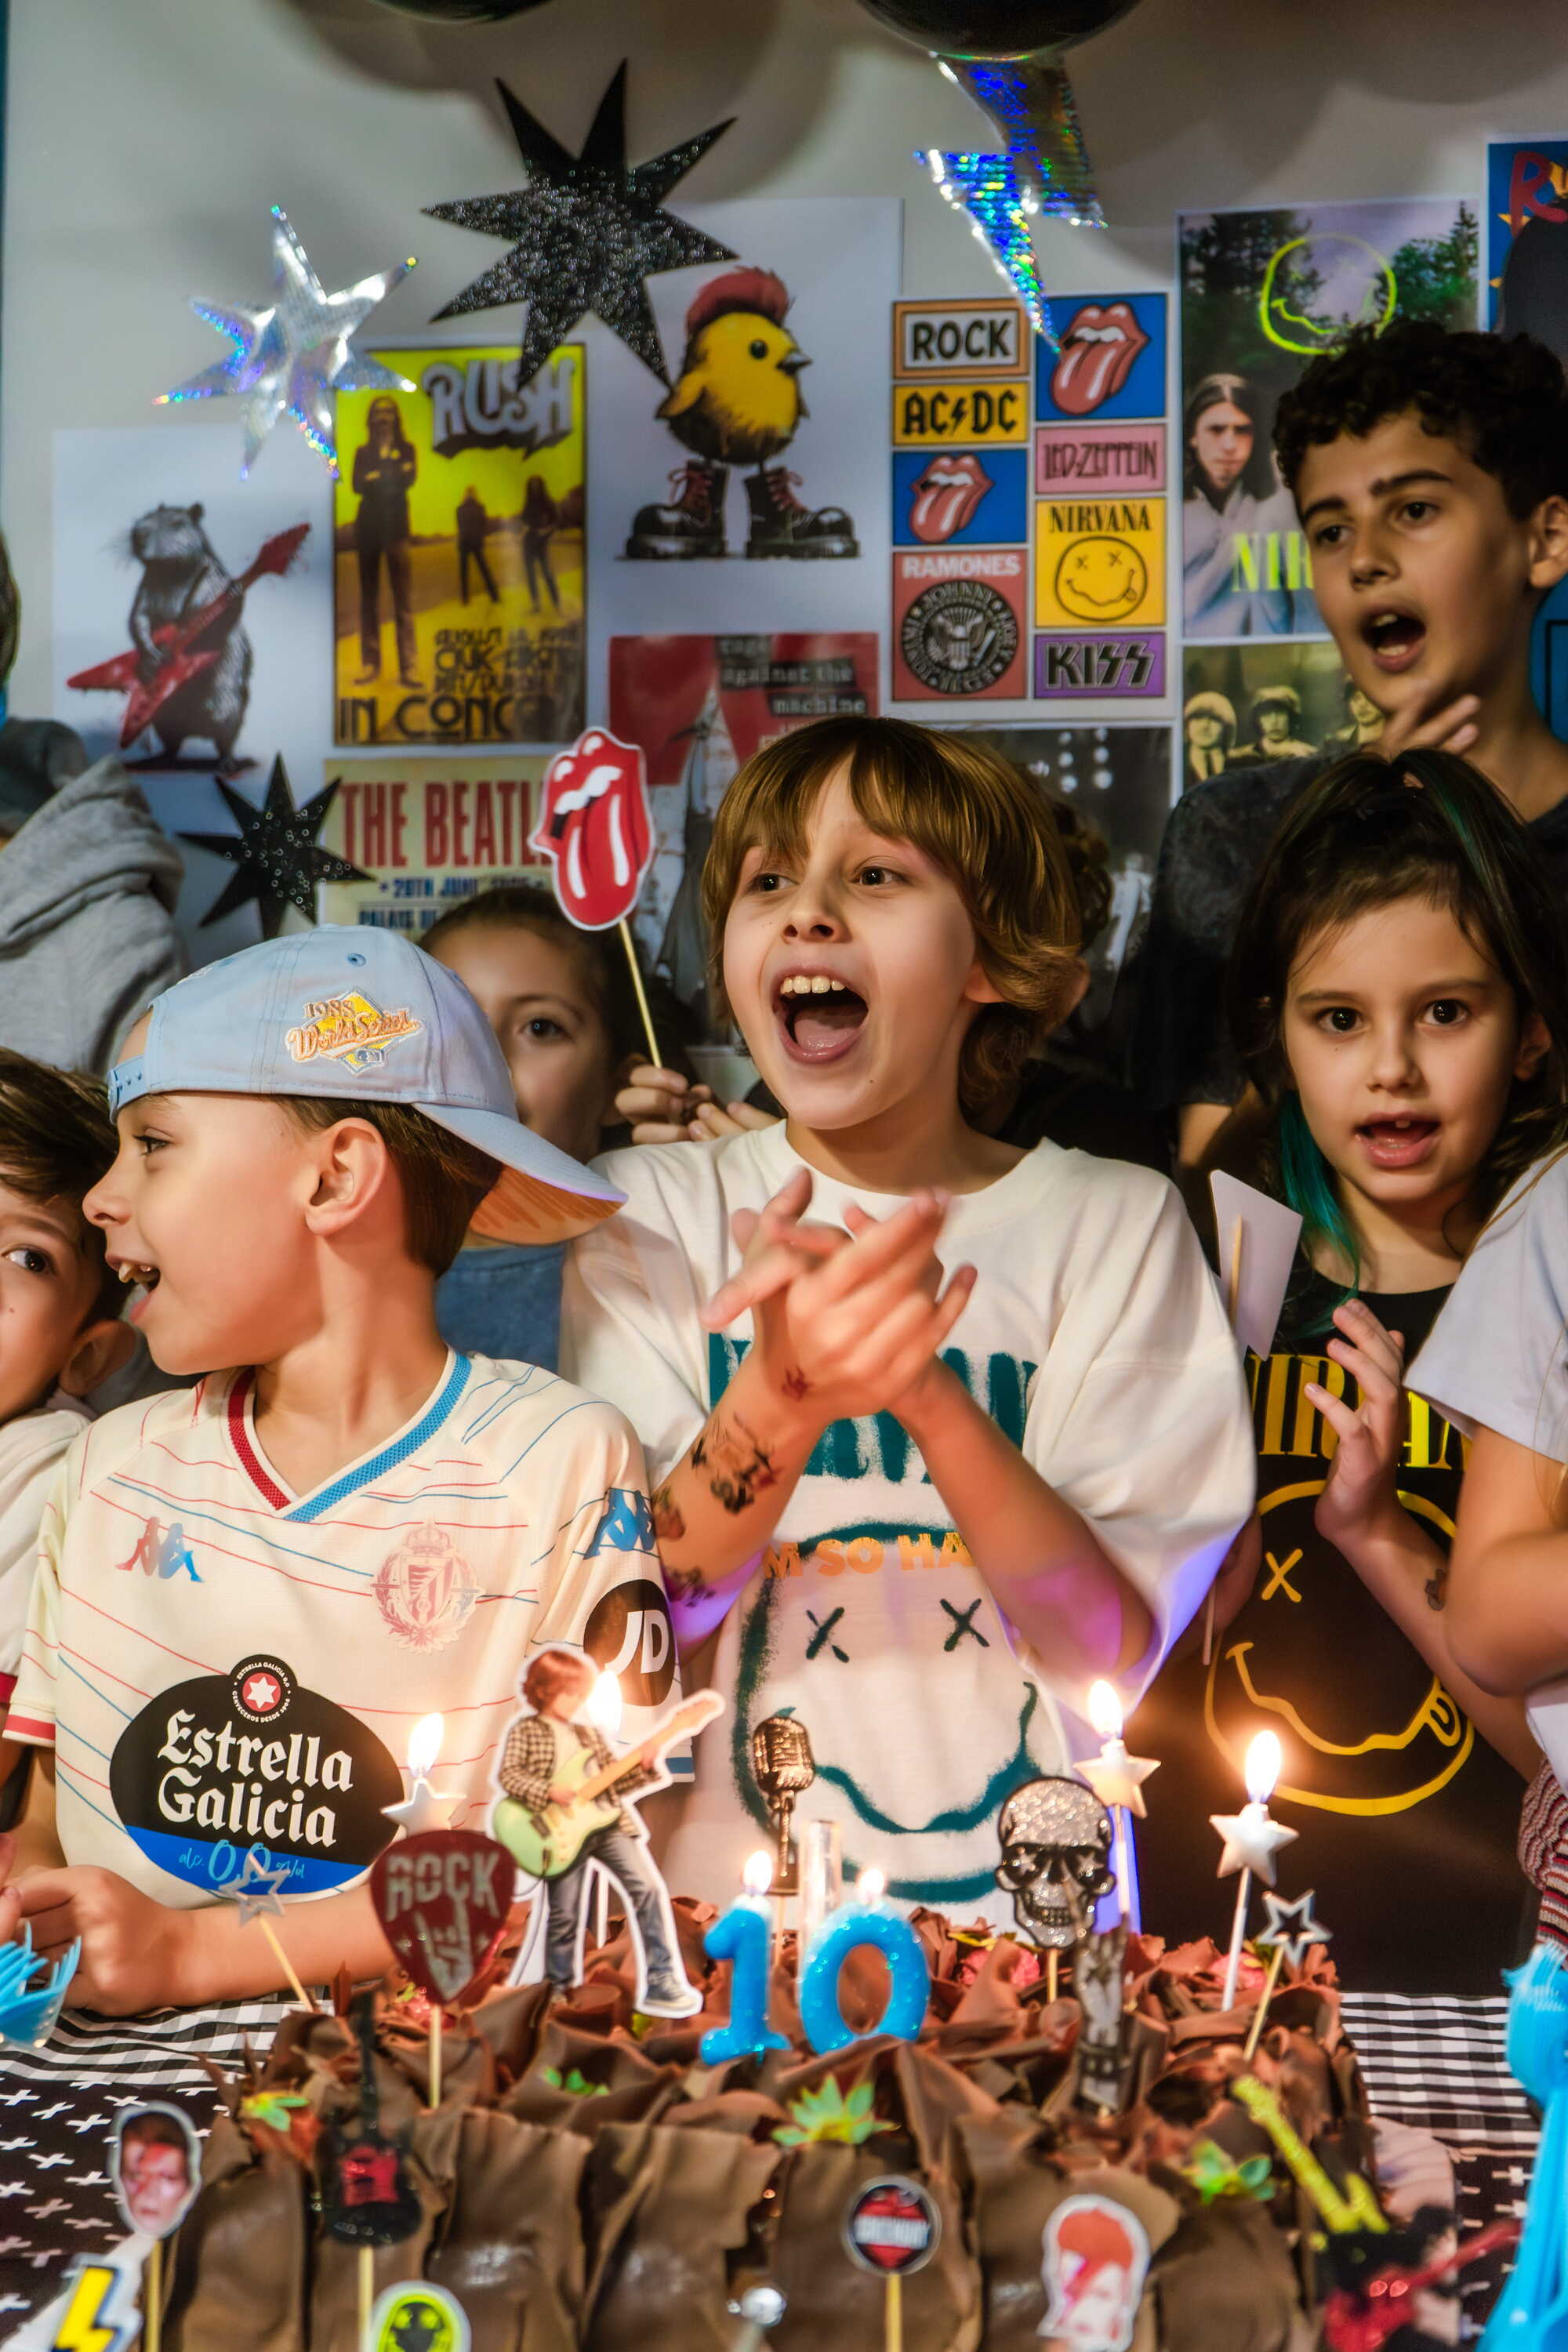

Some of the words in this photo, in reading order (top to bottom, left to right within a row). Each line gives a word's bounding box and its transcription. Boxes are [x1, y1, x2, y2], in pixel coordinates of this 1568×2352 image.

[913, 318, 1011, 361] ROCK
[422, 356, 575, 452] RUSH
[1049, 503, 1152, 535] NIRVANA
[903, 554, 1022, 579] RAMONES
[1046, 640, 1156, 691] KISS
[340, 695, 377, 740] IN
[340, 781, 408, 867] THE
[424, 781, 553, 869] BEATL
[287, 1017, 358, 1062] World
[353, 1008, 416, 1041] Series
[817, 1535, 884, 1577] SO
[604, 1609, 670, 1675] JD
[236, 1662, 263, 1680] ESTRELLA
[263, 1661, 285, 1678] GALICIA
[231, 1690, 260, 1722] CERVECEROS
[260, 1711, 281, 1723] DESDE
[157, 1709, 353, 1792] Estrella
[158, 1767, 336, 1848] Galicia
[387, 1851, 501, 1922] ROCK
[699, 1894, 931, 2064] 10
